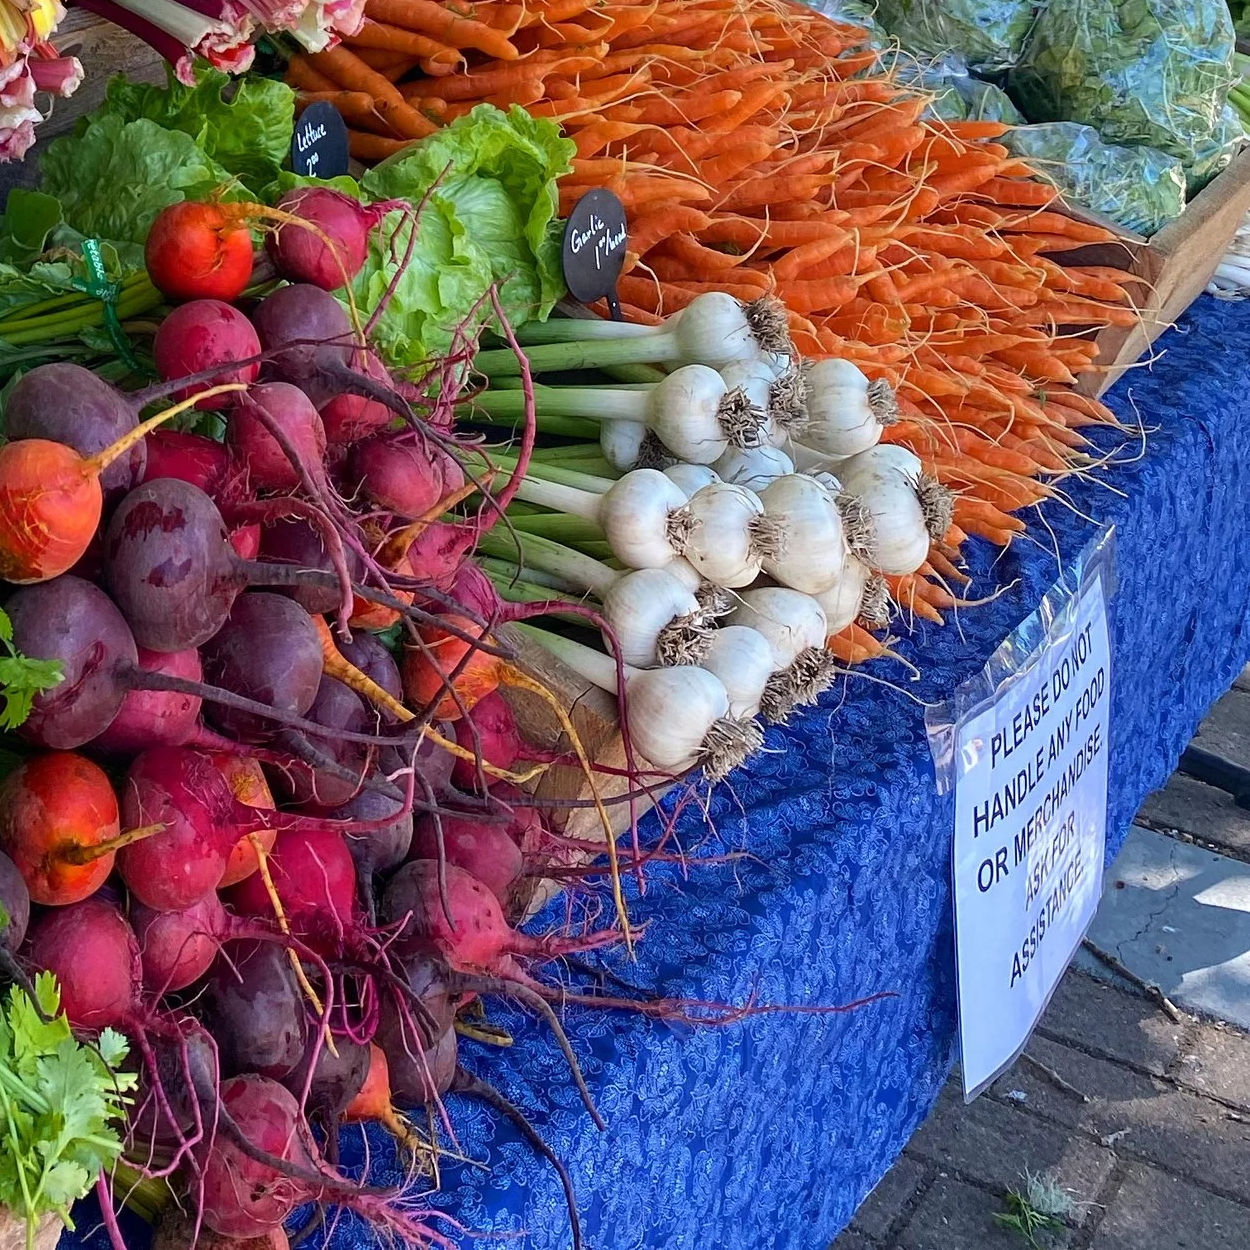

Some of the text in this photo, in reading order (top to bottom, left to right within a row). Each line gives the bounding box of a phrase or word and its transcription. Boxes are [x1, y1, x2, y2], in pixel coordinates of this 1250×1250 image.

[571, 214, 605, 254] Garlic
[991, 621, 1093, 770] PLEASE DO NOT
[973, 666, 1105, 838] HANDLE ANY FOOD
[977, 845, 1010, 894] OR
[1025, 810, 1076, 912] ASK FOR
